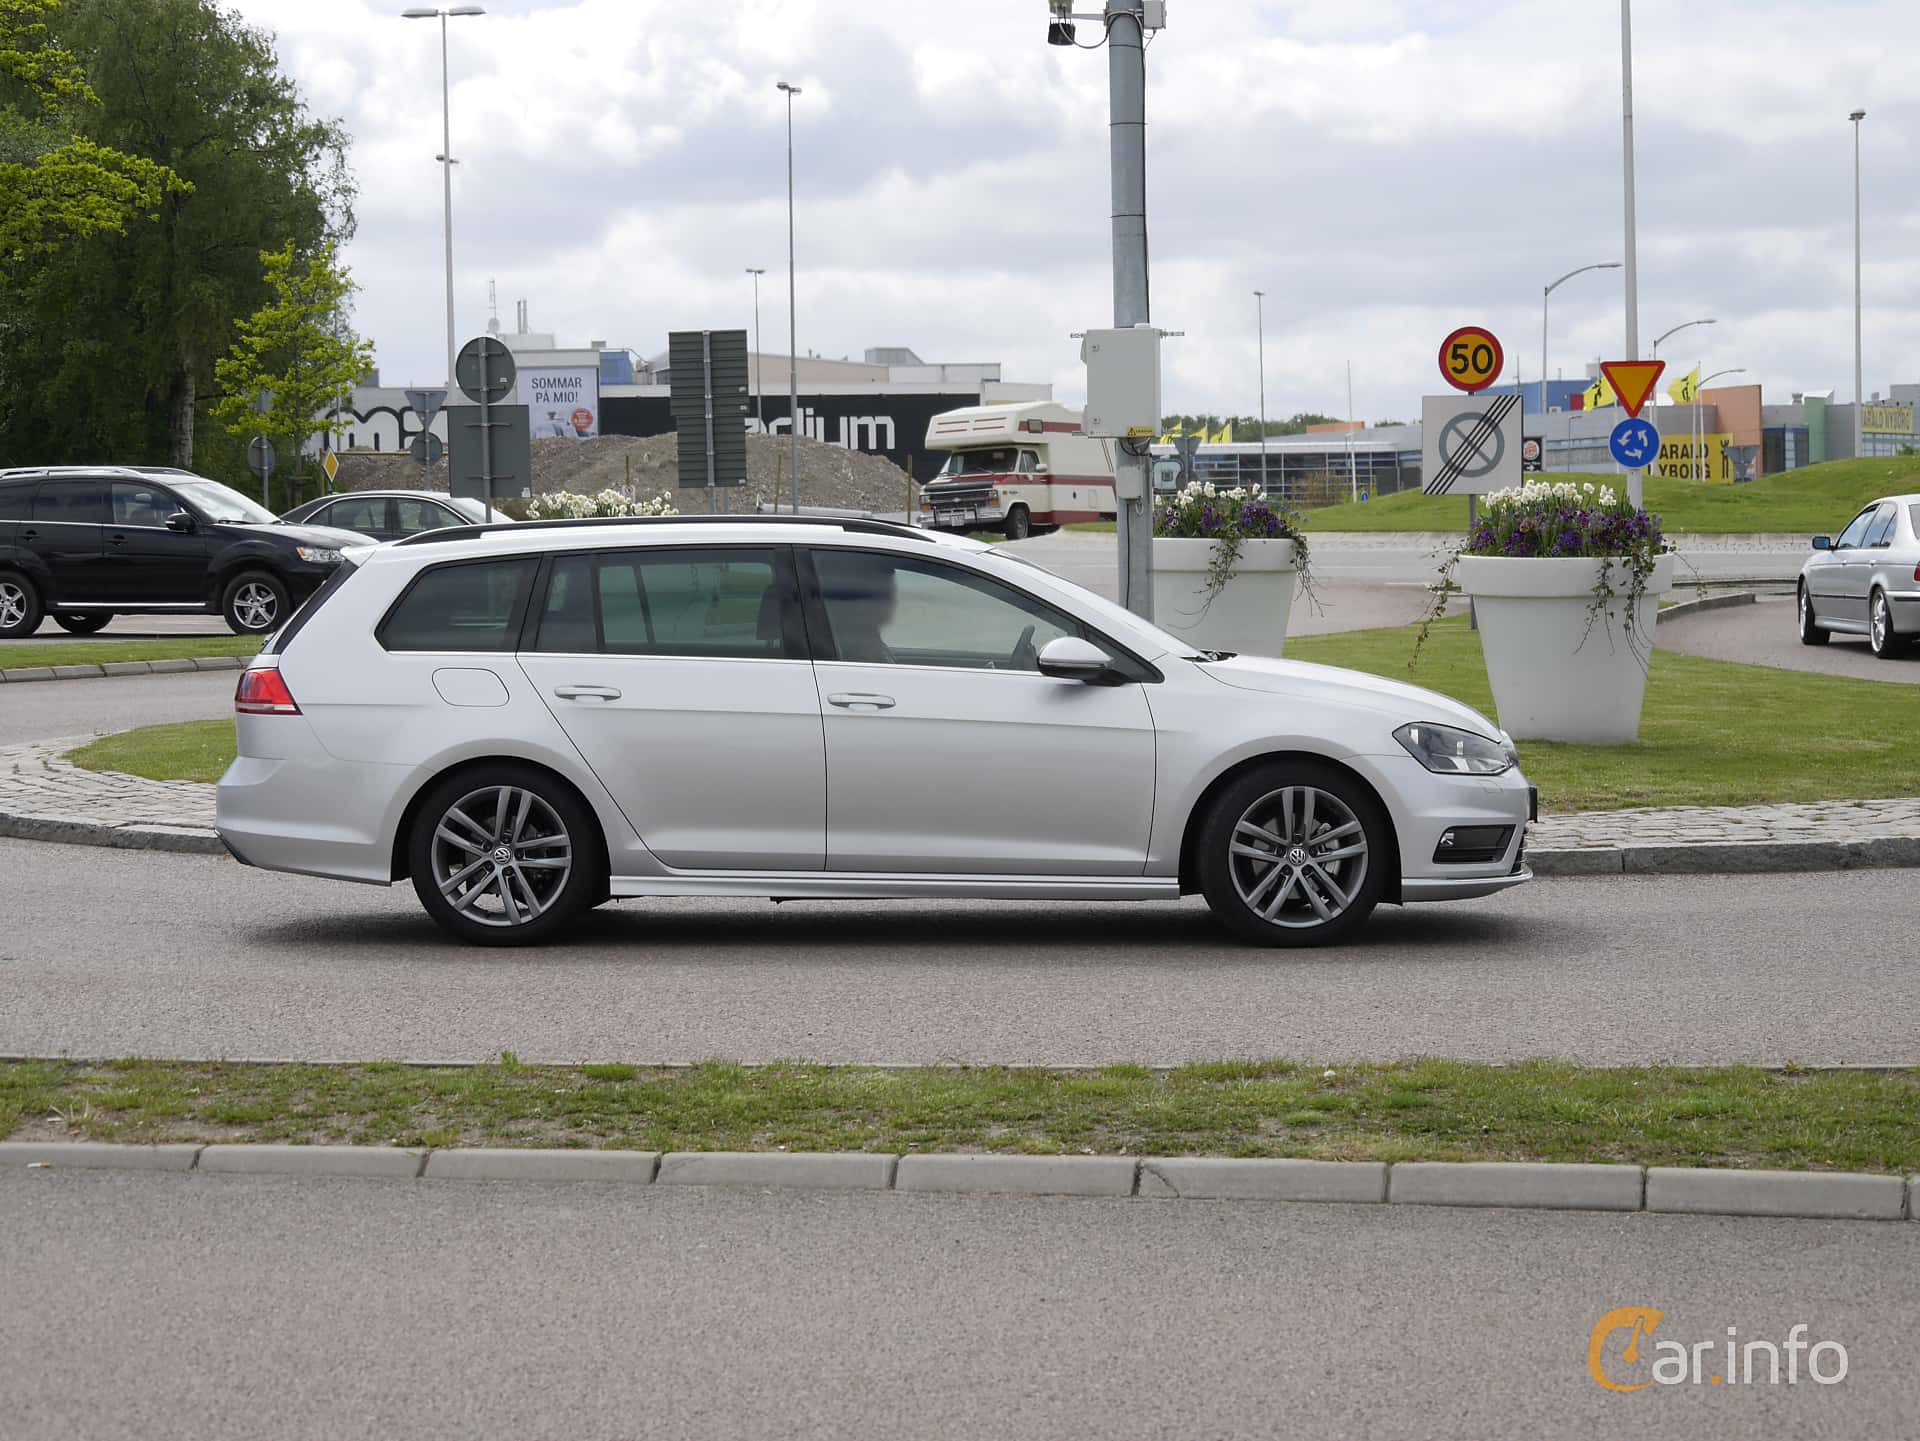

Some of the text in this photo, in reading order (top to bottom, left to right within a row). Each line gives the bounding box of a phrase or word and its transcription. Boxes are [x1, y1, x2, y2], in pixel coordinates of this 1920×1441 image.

[1450, 343, 1494, 375] 50
[531, 377, 583, 389] SOMMAR
[535, 389, 578, 403] PÅ MIO!
[1659, 443, 1709, 460] ARALD
